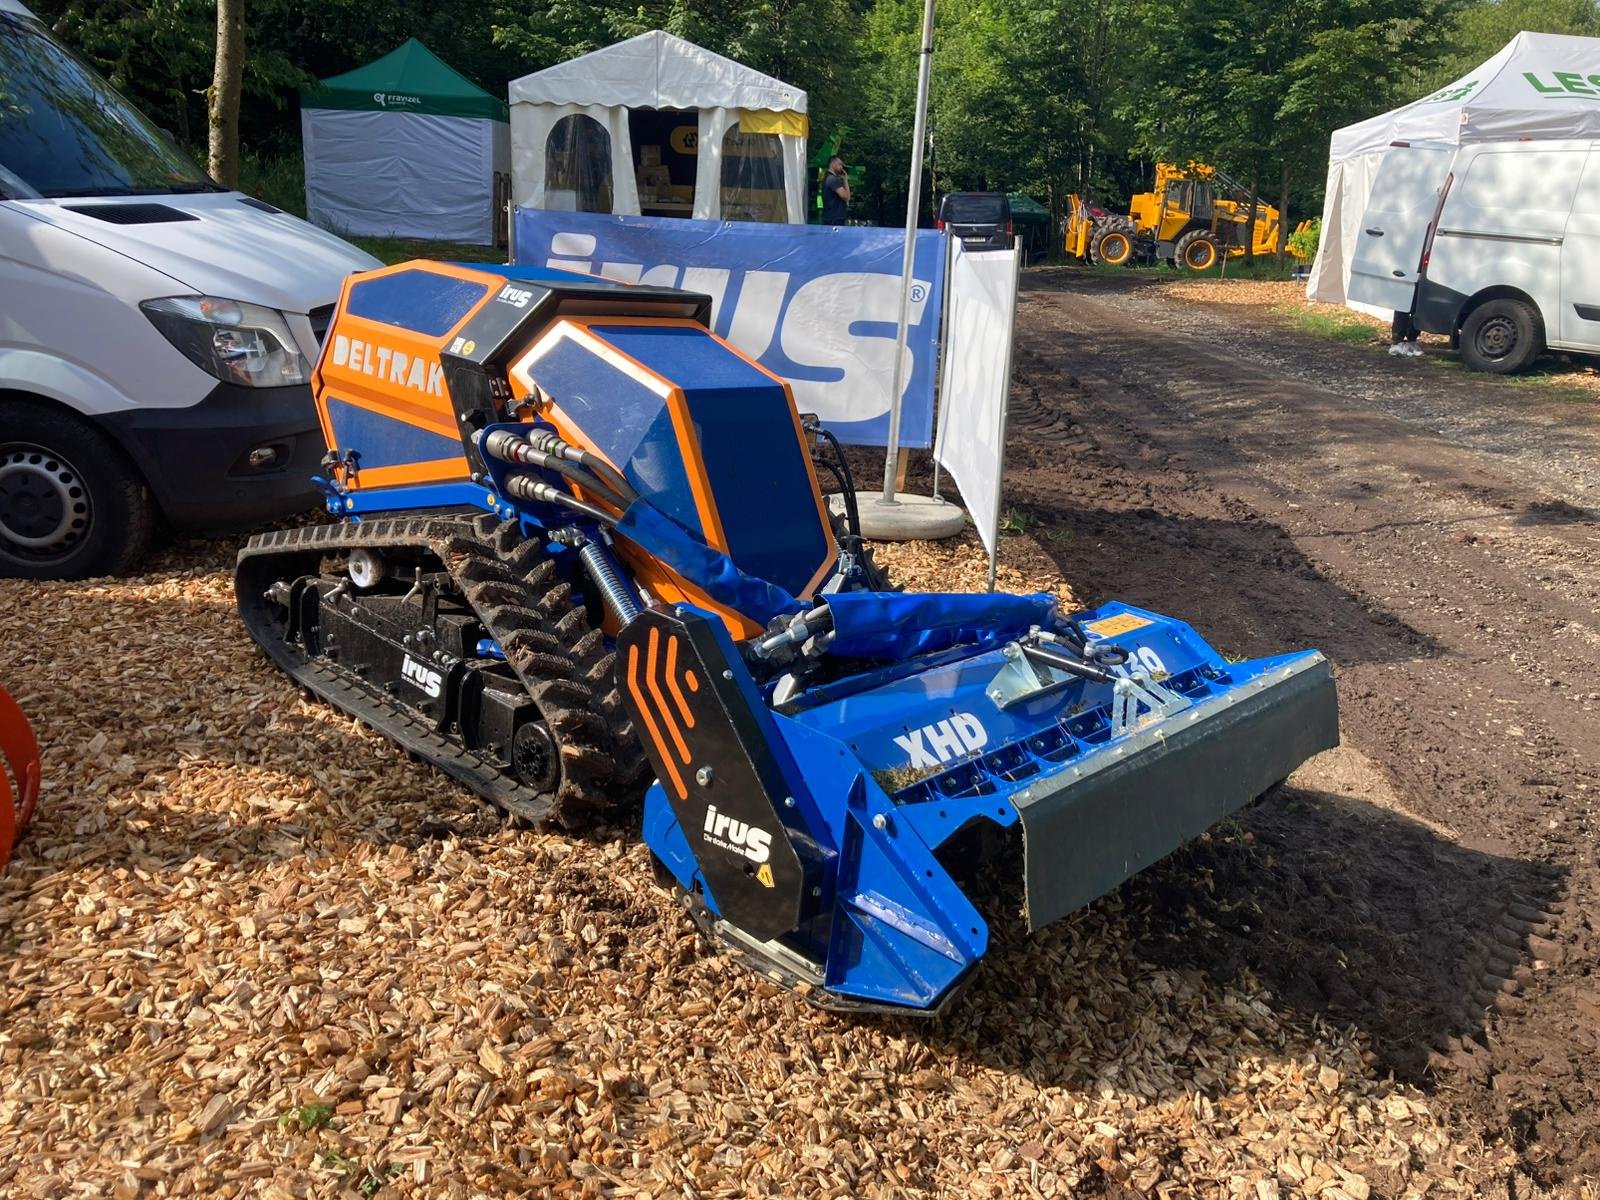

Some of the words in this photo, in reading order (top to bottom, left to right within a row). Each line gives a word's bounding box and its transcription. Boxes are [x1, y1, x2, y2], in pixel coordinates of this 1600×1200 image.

[499, 284, 533, 308] irus
[545, 232, 932, 423] us
[333, 334, 444, 398] DELTRAK
[401, 653, 442, 698] irus
[892, 712, 988, 771] XHD
[703, 803, 773, 863] irus
